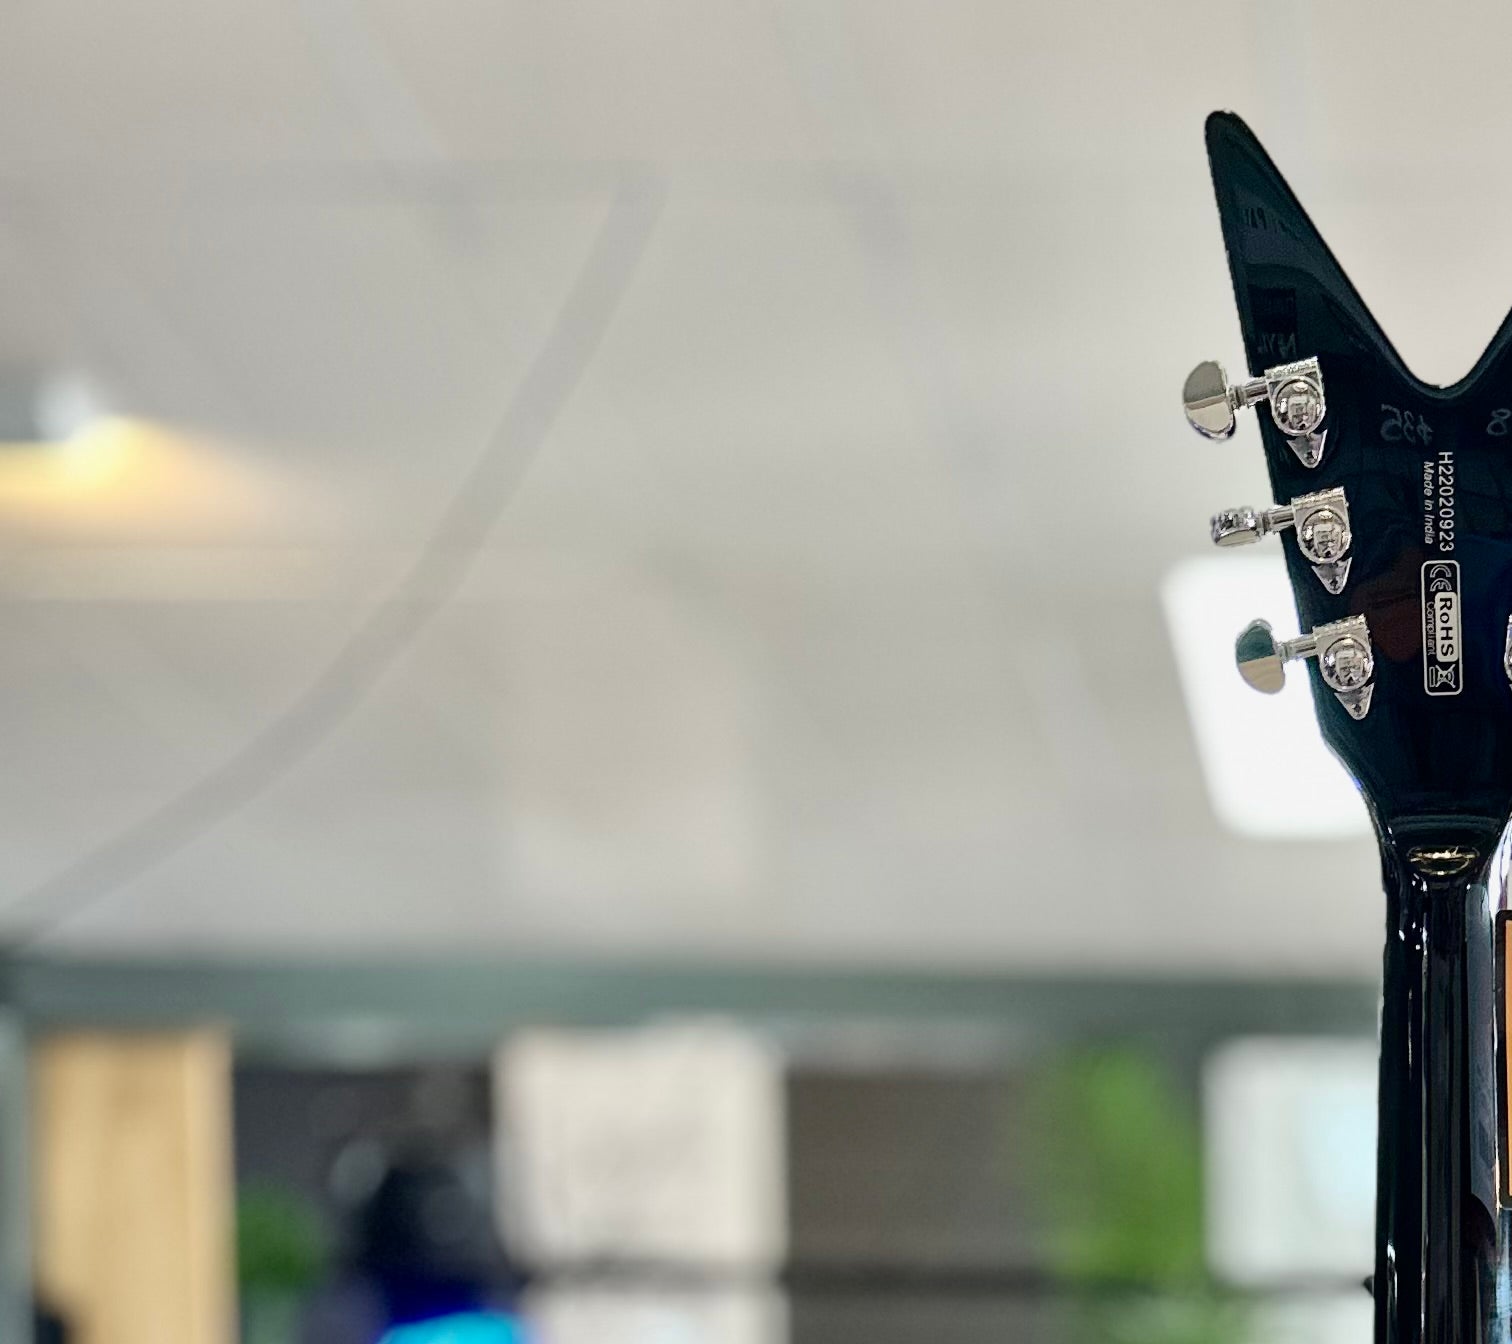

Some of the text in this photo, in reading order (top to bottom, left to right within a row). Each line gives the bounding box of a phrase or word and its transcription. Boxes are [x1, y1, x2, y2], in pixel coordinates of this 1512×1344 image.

[1424, 461, 1434, 497] Made
[1438, 451, 1455, 552] H22020923
[1424, 514, 1435, 545] India
[1426, 601, 1436, 656] Compliant
[1439, 597, 1454, 658] RoHS
